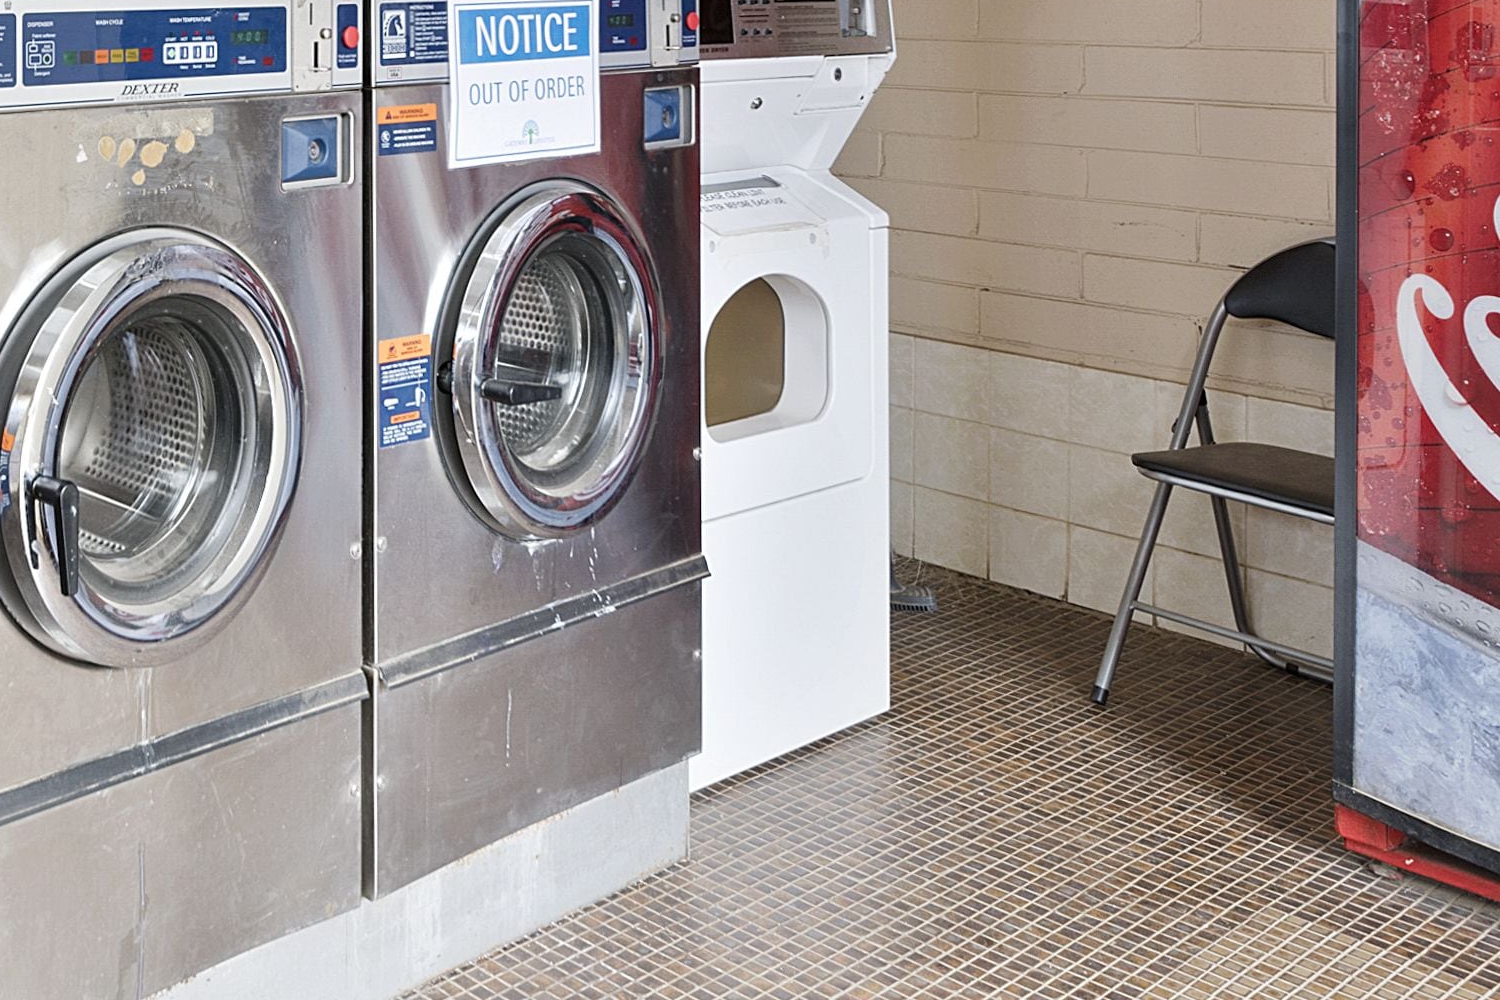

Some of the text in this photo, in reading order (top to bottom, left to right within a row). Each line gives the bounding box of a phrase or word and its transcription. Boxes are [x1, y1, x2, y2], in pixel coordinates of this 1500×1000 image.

[476, 12, 578, 57] NOTICE
[122, 83, 179, 96] DEXTER
[469, 76, 585, 105] OUT OF ORDER
